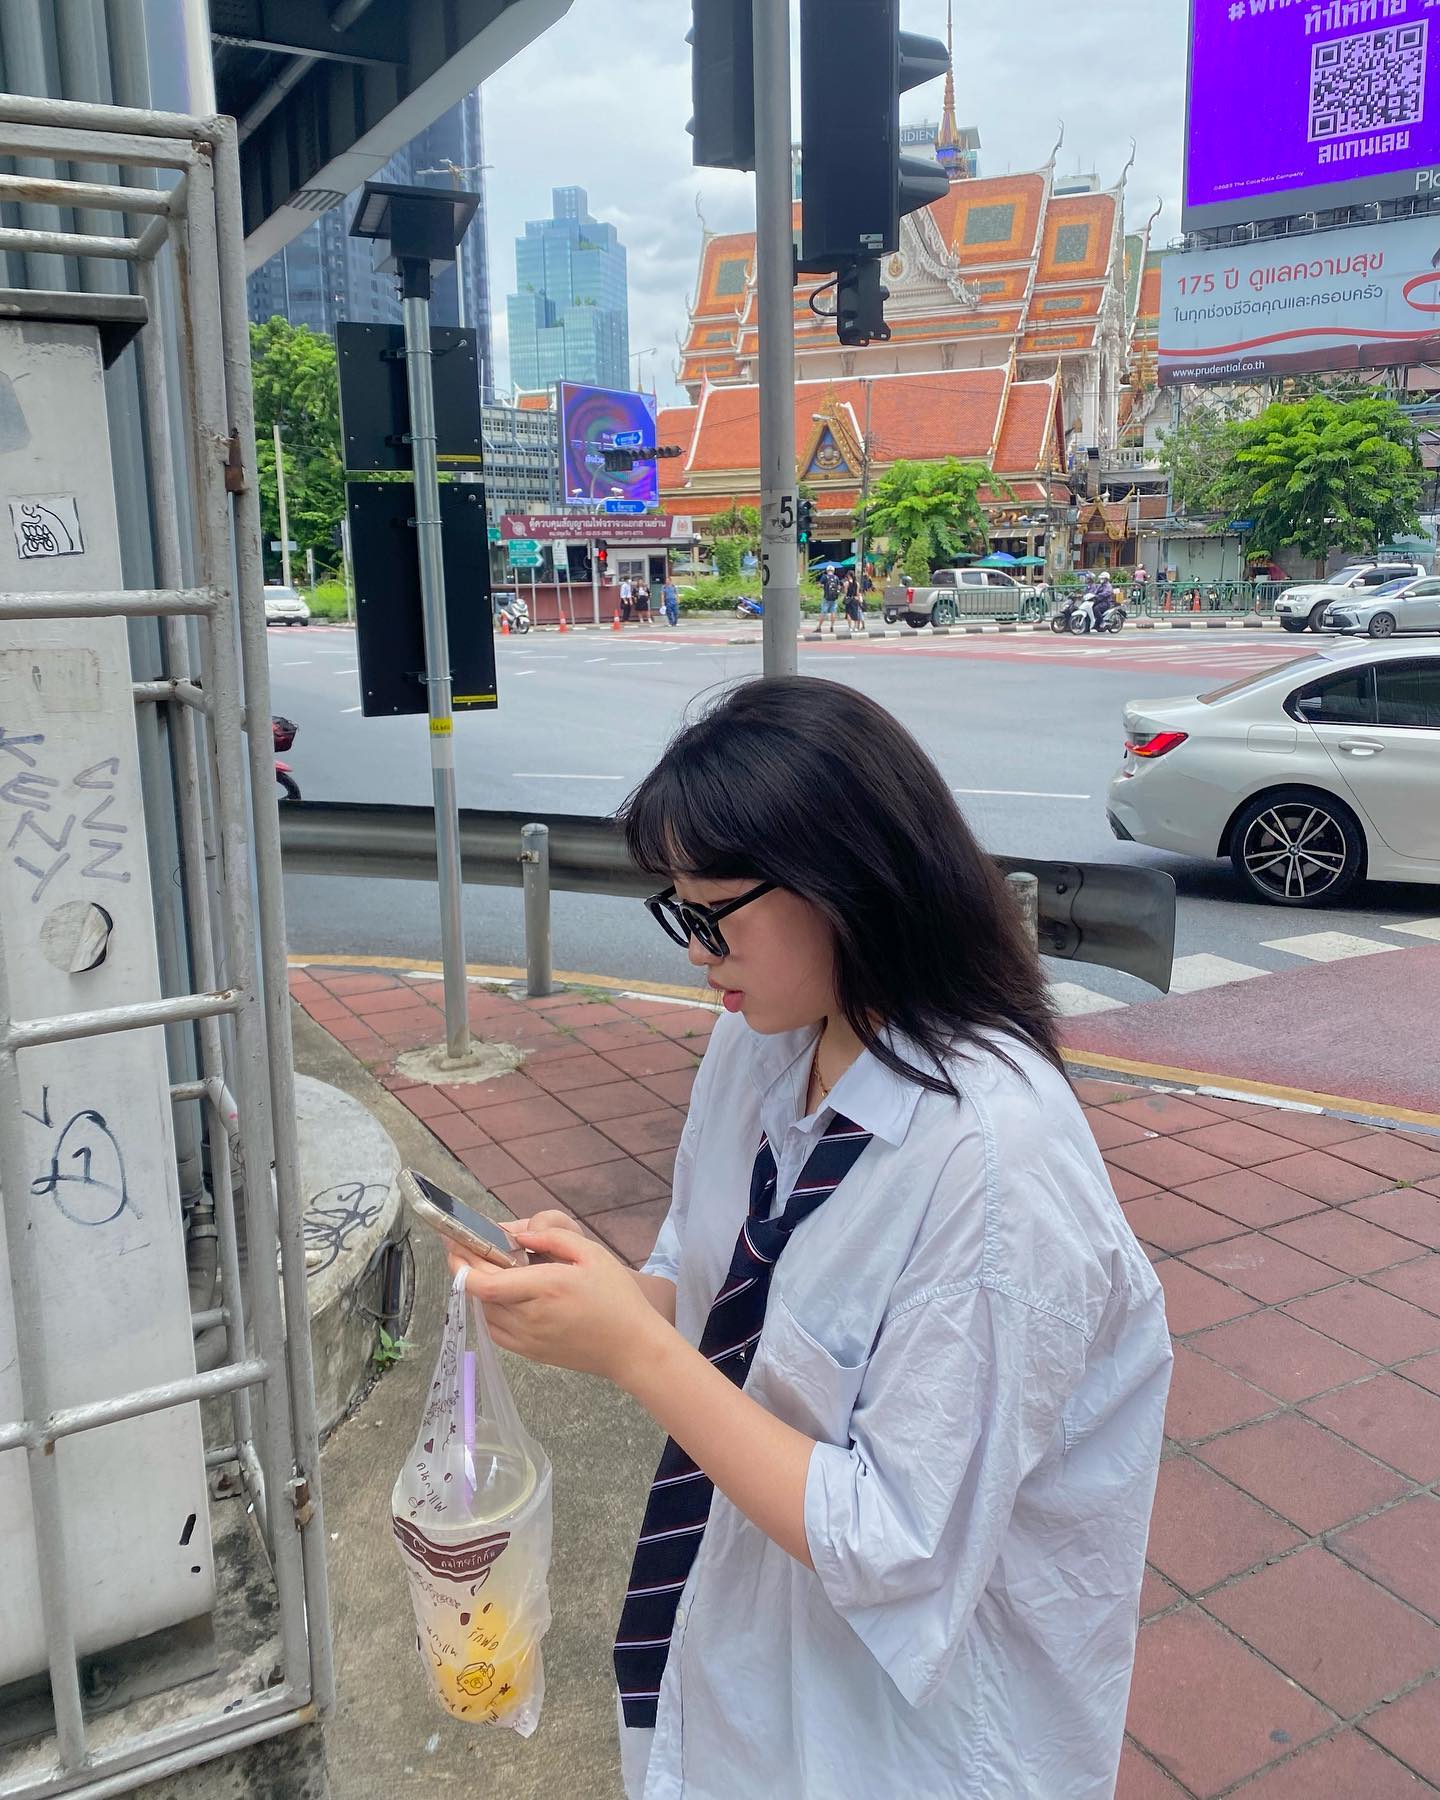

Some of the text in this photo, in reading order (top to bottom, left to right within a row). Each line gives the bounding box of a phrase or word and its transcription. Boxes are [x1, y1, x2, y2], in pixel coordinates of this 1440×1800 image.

[1318, 130, 1410, 164] สแกนเลย
[1276, 171, 1304, 180] Company
[1177, 252, 1384, 295] 175 ปี ดูแลความสุข
[1174, 284, 1384, 324] ในทุกช่วงชีวิตคุณและครอบครัว
[1172, 360, 1265, 378] www.prudential.co.th
[780, 495, 793, 528] 5
